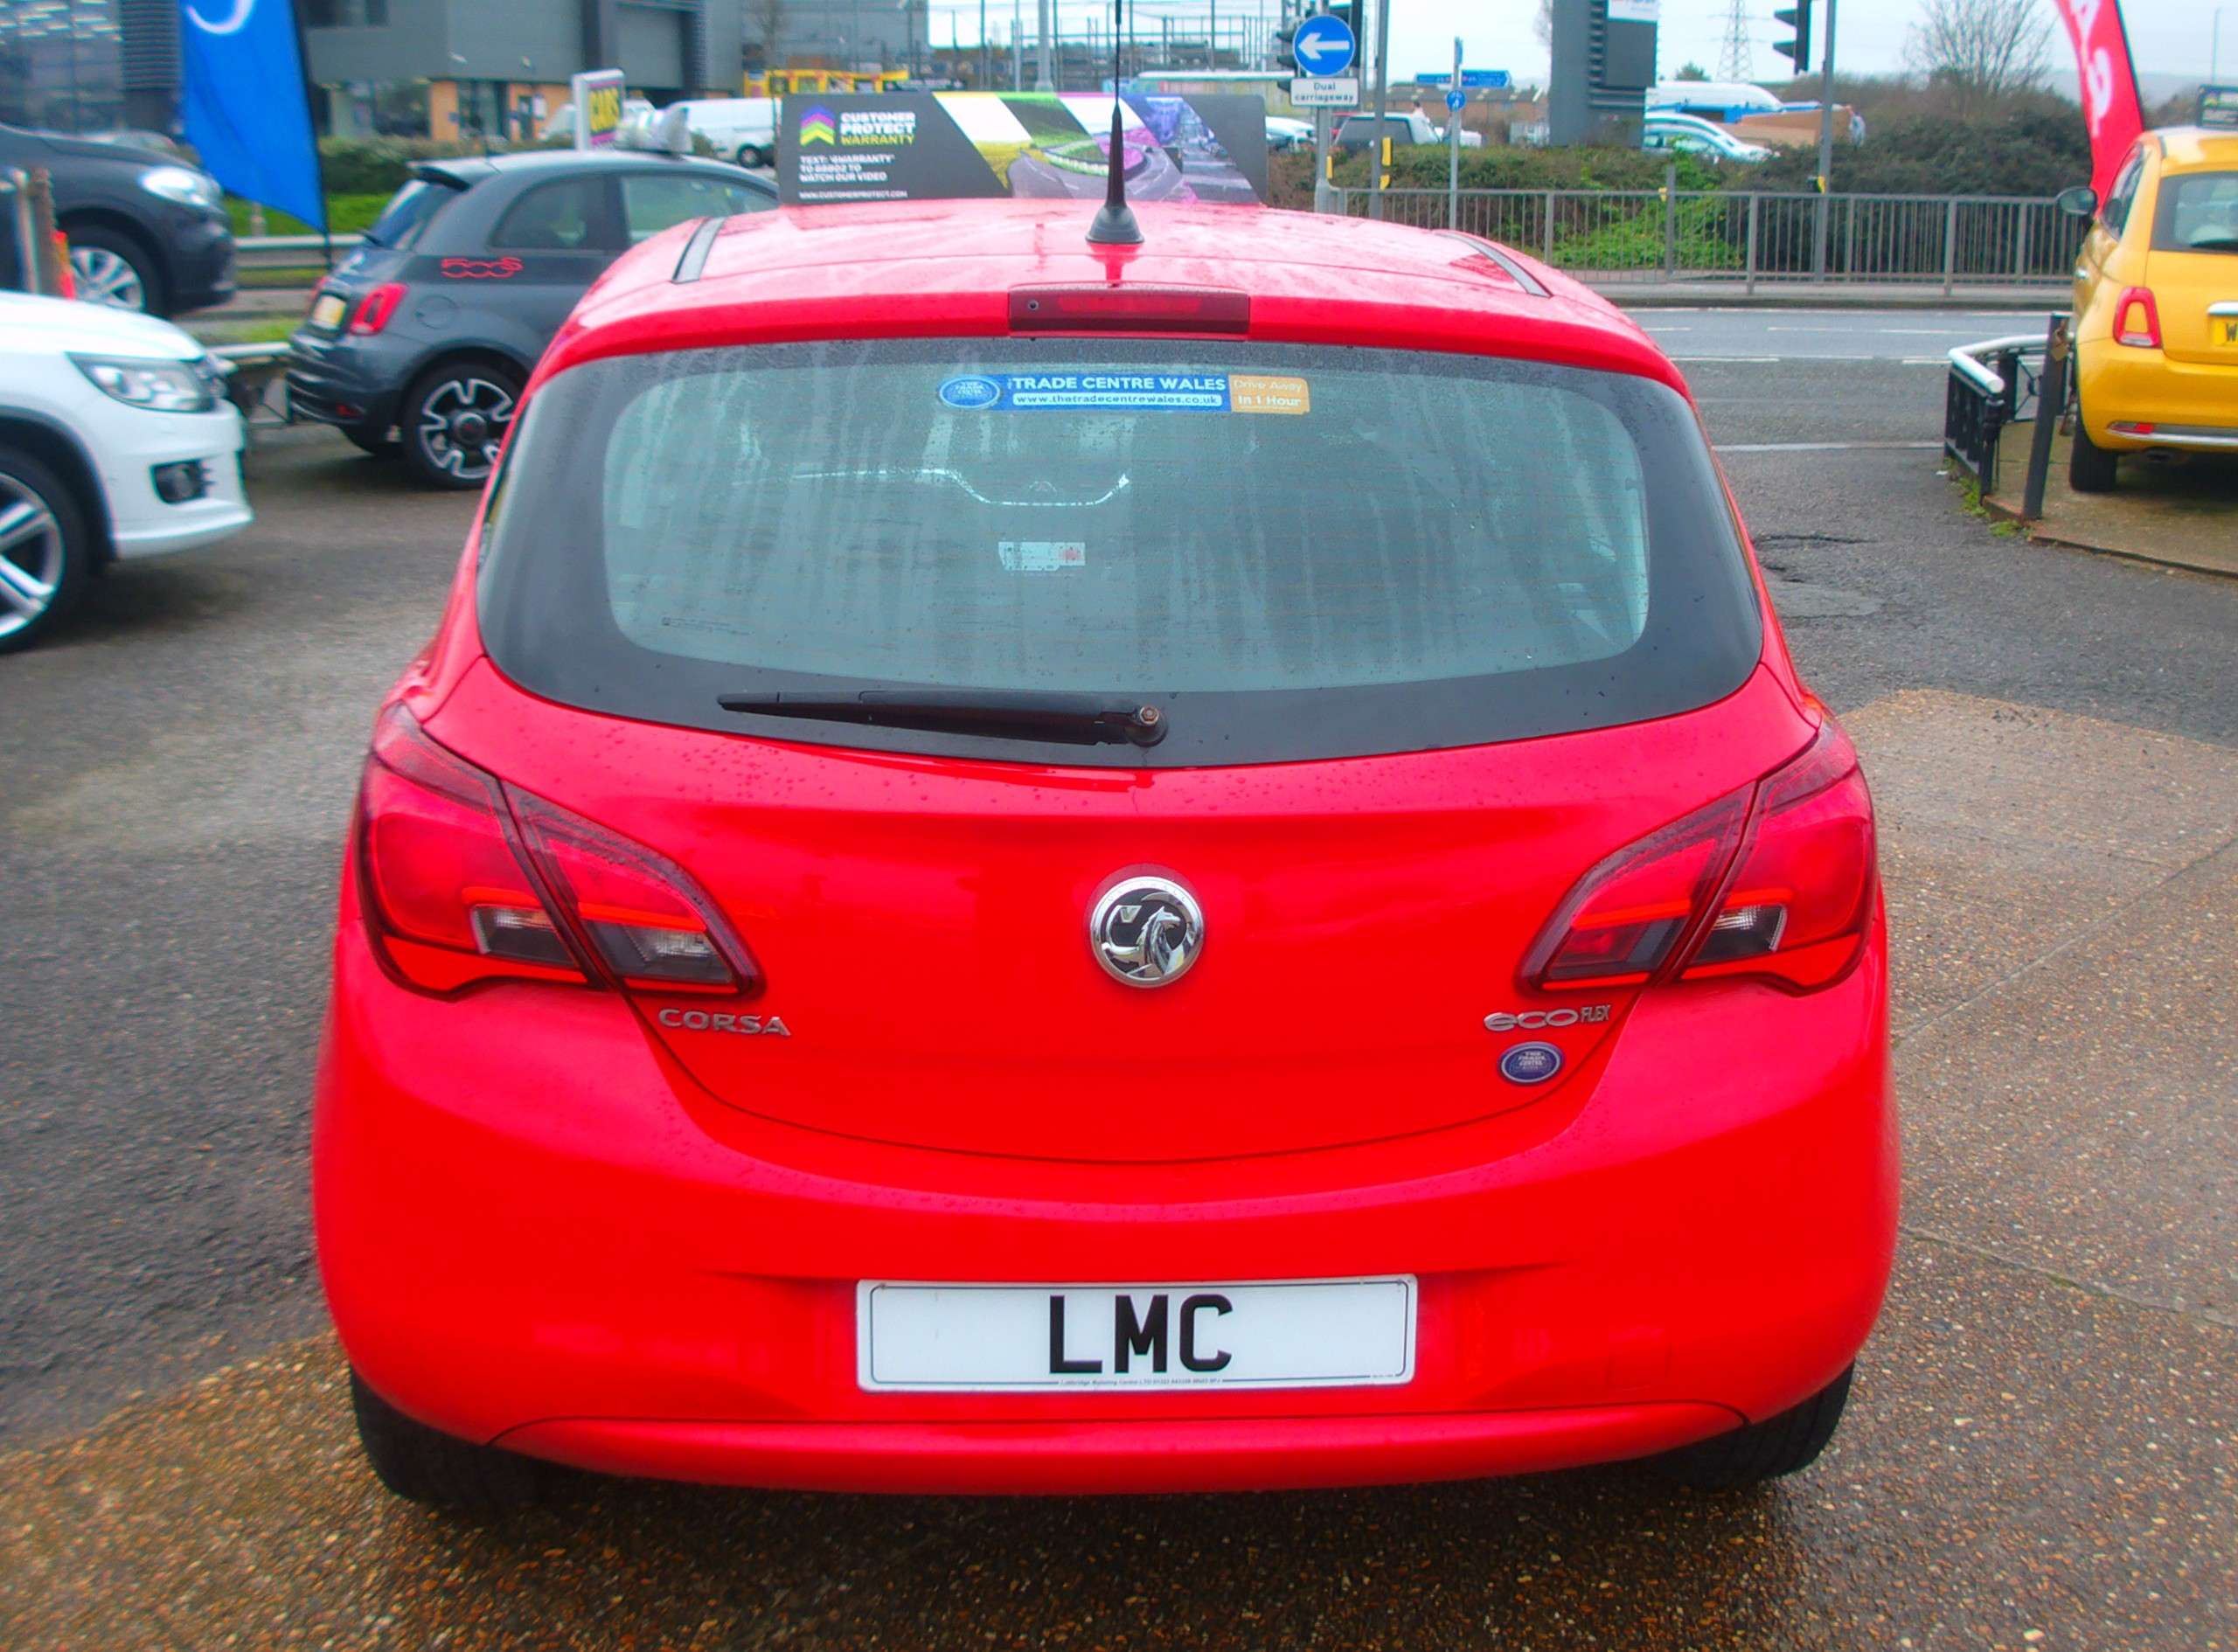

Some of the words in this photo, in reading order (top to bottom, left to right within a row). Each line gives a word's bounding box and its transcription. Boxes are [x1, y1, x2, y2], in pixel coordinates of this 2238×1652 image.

[1313, 82, 1336, 91] Dual
[1295, 93, 1354, 102] carriageway
[840, 112, 915, 122] CUSTOMER
[840, 122, 915, 135] PROTECT
[840, 135, 914, 146] WARRANTY
[799, 164, 814, 173] TO
[849, 163, 862, 172] TO
[799, 173, 834, 182] WATCH
[835, 172, 856, 181] OUR
[856, 171, 887, 181] VIDEO
[1012, 377, 1077, 389] TRADE
[1081, 377, 1155, 390] CENTRE
[1159, 377, 1227, 390] WALES
[1234, 379, 1266, 390] Drive
[1269, 380, 1302, 392] Away
[1016, 395, 1217, 404] www.thetradecentrewales.co.uk
[1238, 394, 1251, 405] In
[1268, 395, 1302, 406] Hour
[658, 1009, 791, 1037] CORSA
[1049, 1294, 1233, 1374] LMC
